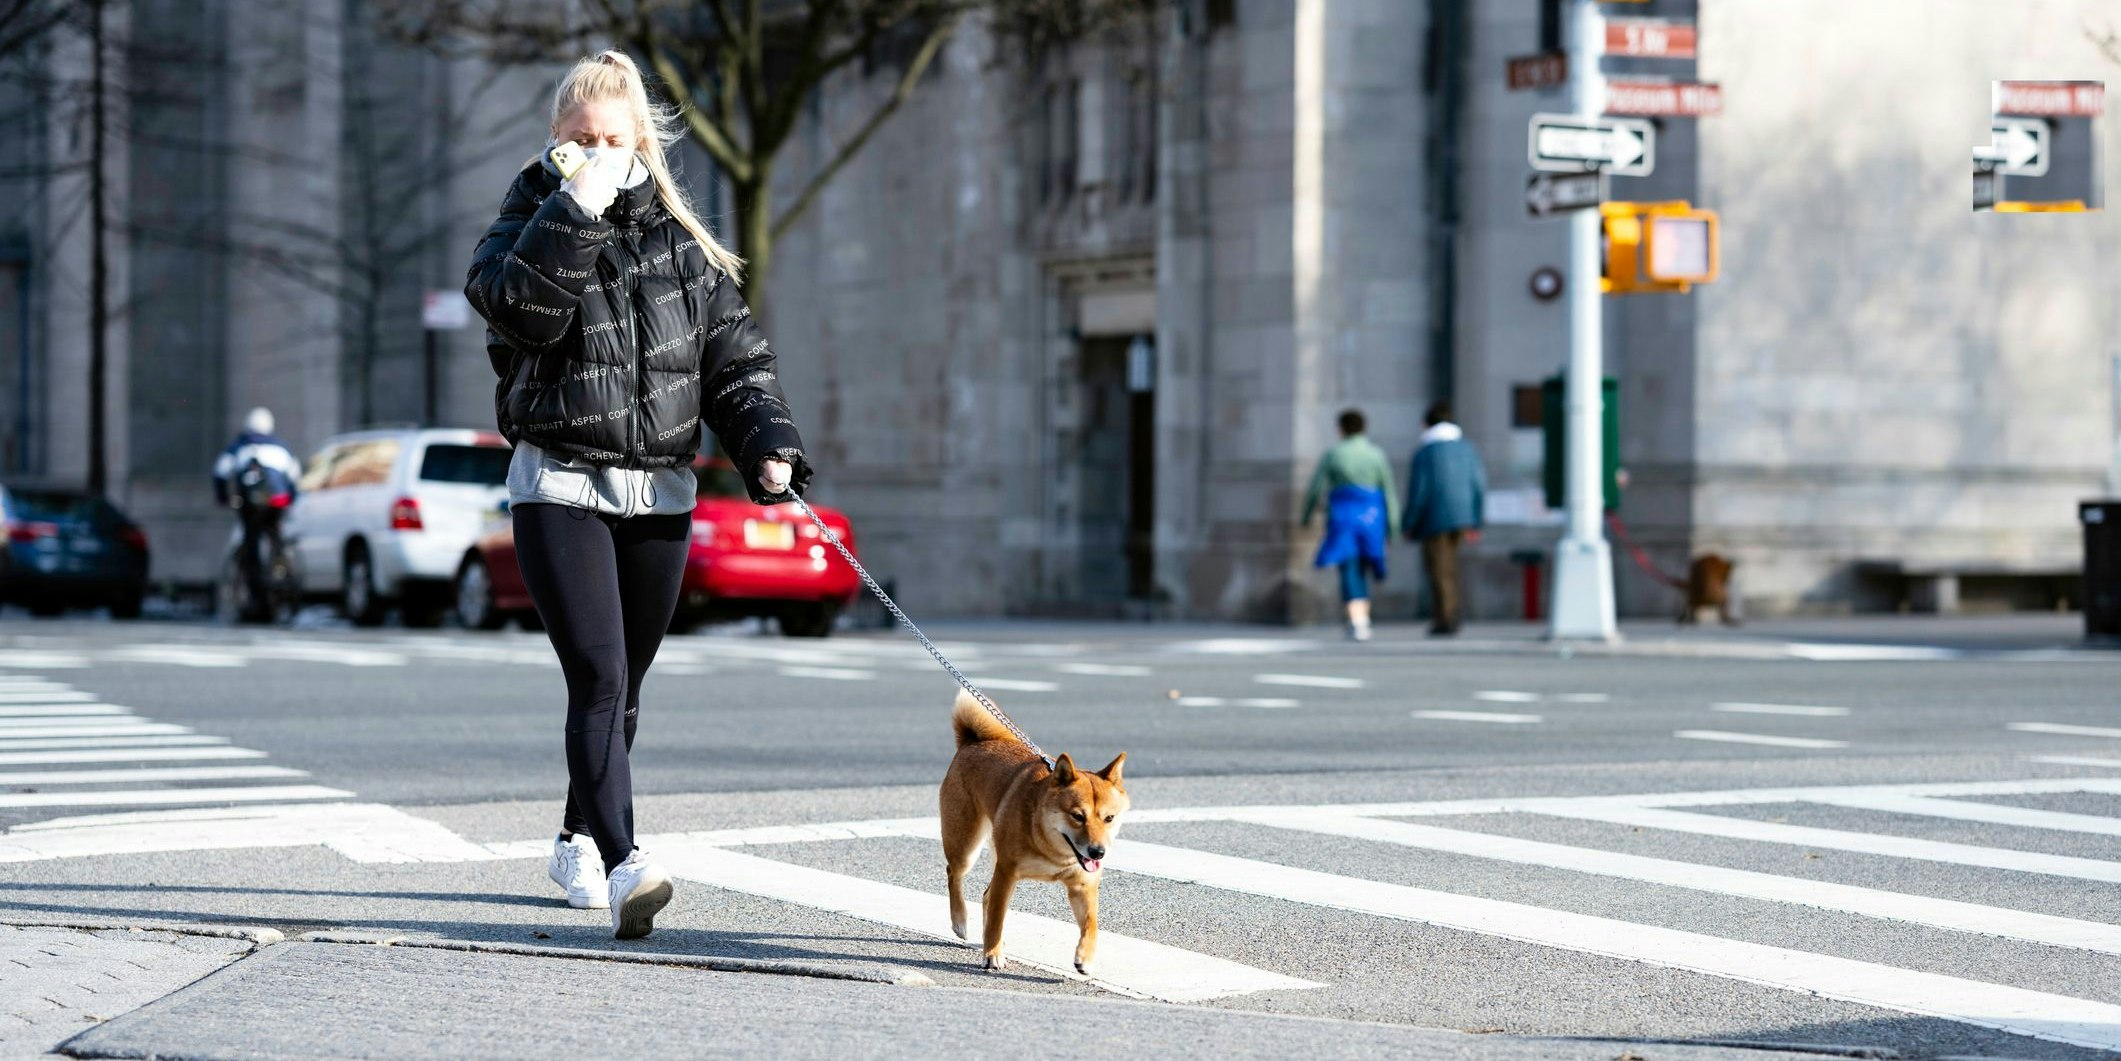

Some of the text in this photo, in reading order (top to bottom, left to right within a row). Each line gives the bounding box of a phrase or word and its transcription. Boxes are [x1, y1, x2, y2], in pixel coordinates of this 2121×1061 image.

[538, 219, 572, 234] NISEKO
[556, 267, 588, 280] MORITZ
[519, 301, 563, 317] ZERMATT
[644, 337, 682, 359] AMPEZZO
[572, 366, 607, 382] NISEKO
[668, 376, 689, 393] ASPEN
[571, 413, 602, 428] ASPEN
